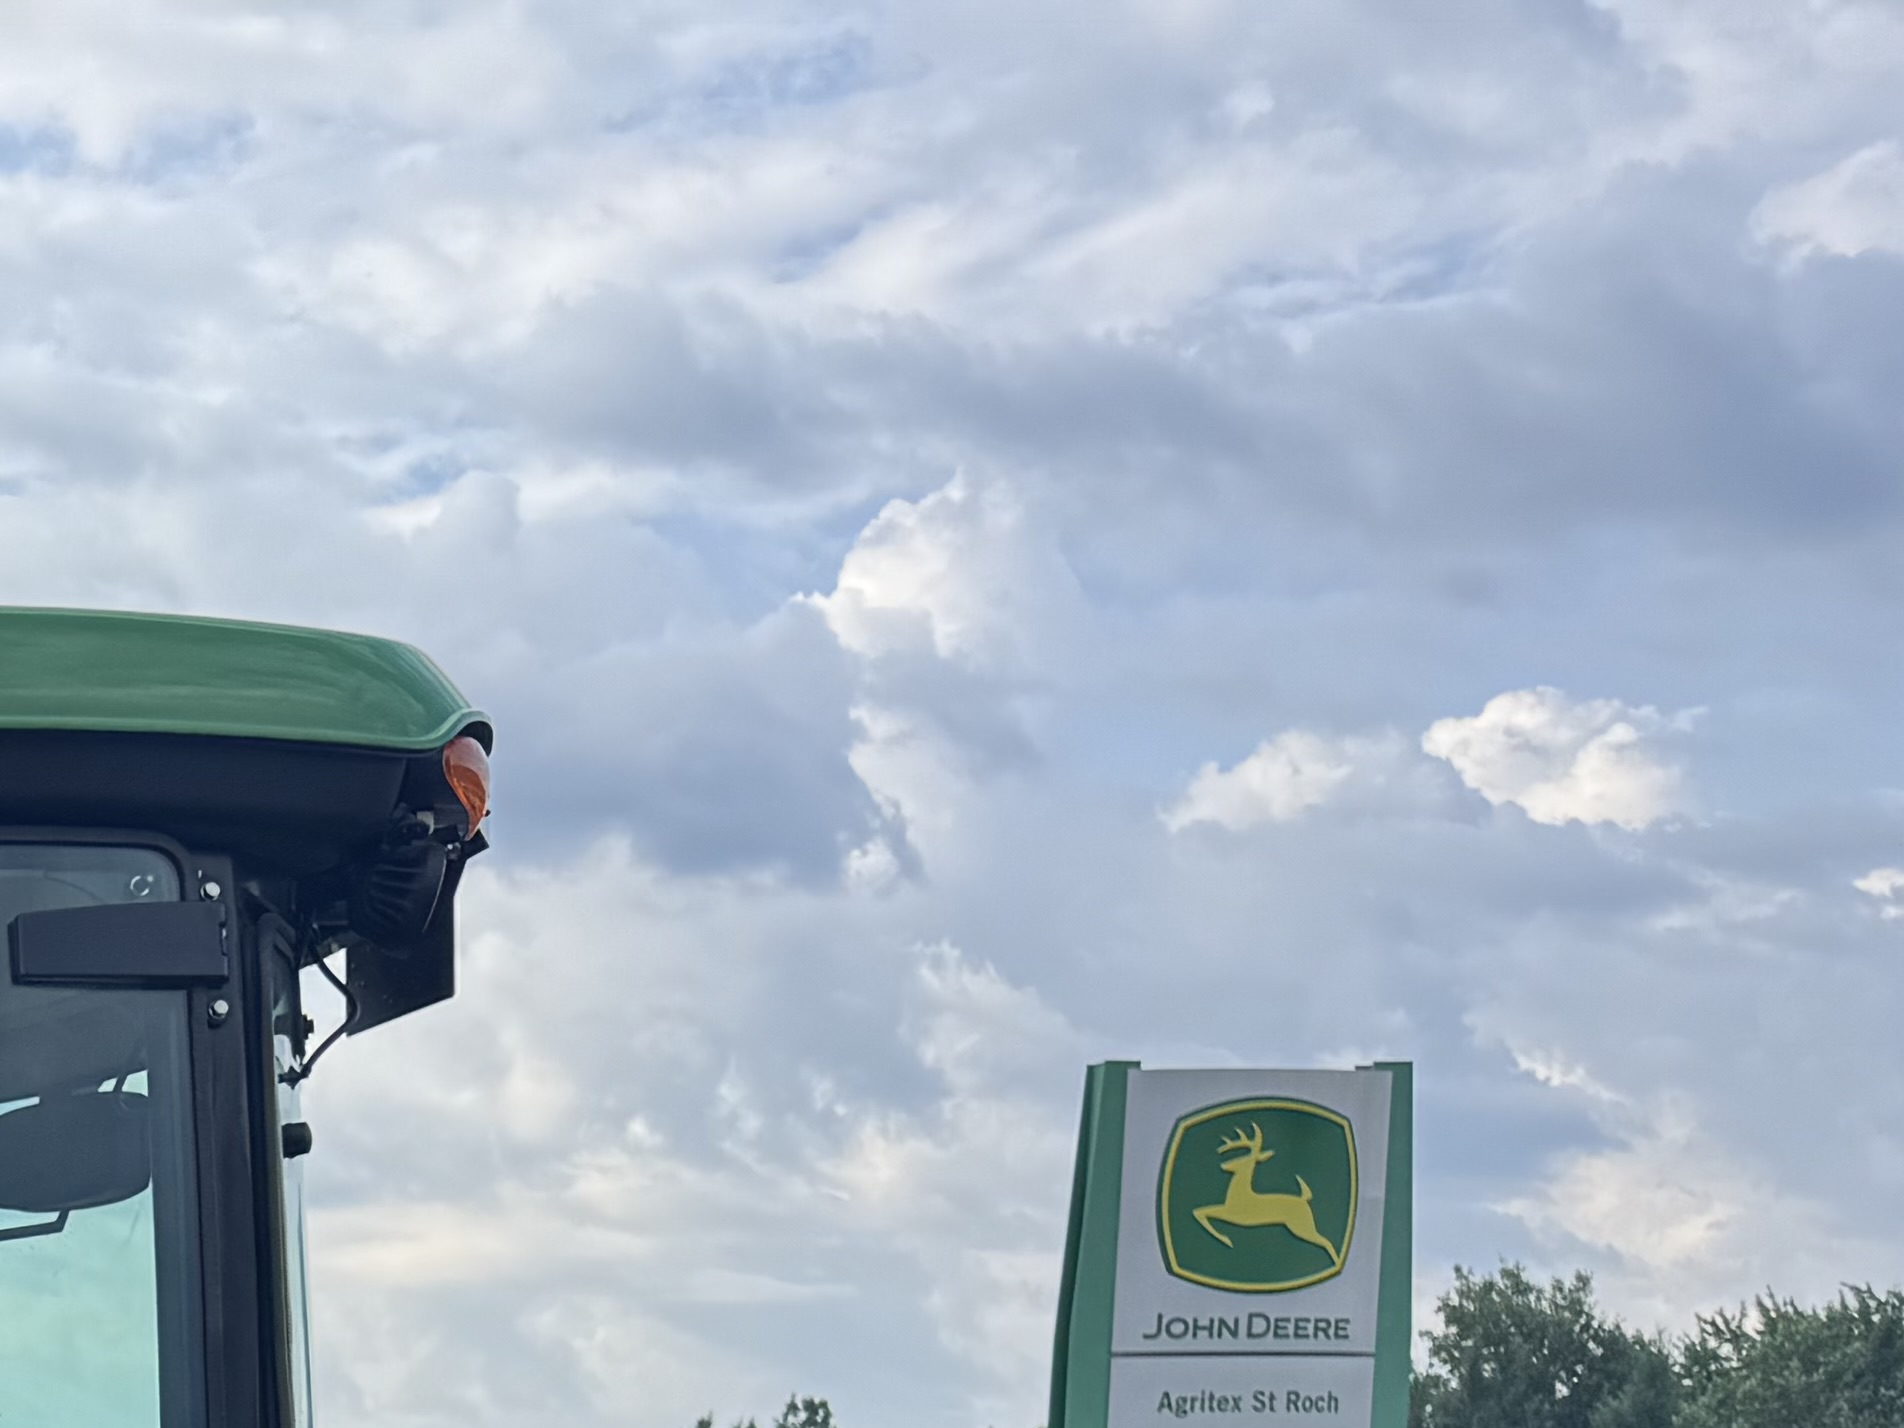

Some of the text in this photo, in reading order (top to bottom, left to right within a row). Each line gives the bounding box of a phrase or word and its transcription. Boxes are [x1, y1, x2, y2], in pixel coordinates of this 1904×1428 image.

[1143, 1313, 1351, 1340] JOHN DEERE
[1157, 1390, 1339, 1418] Agritex St Roch
